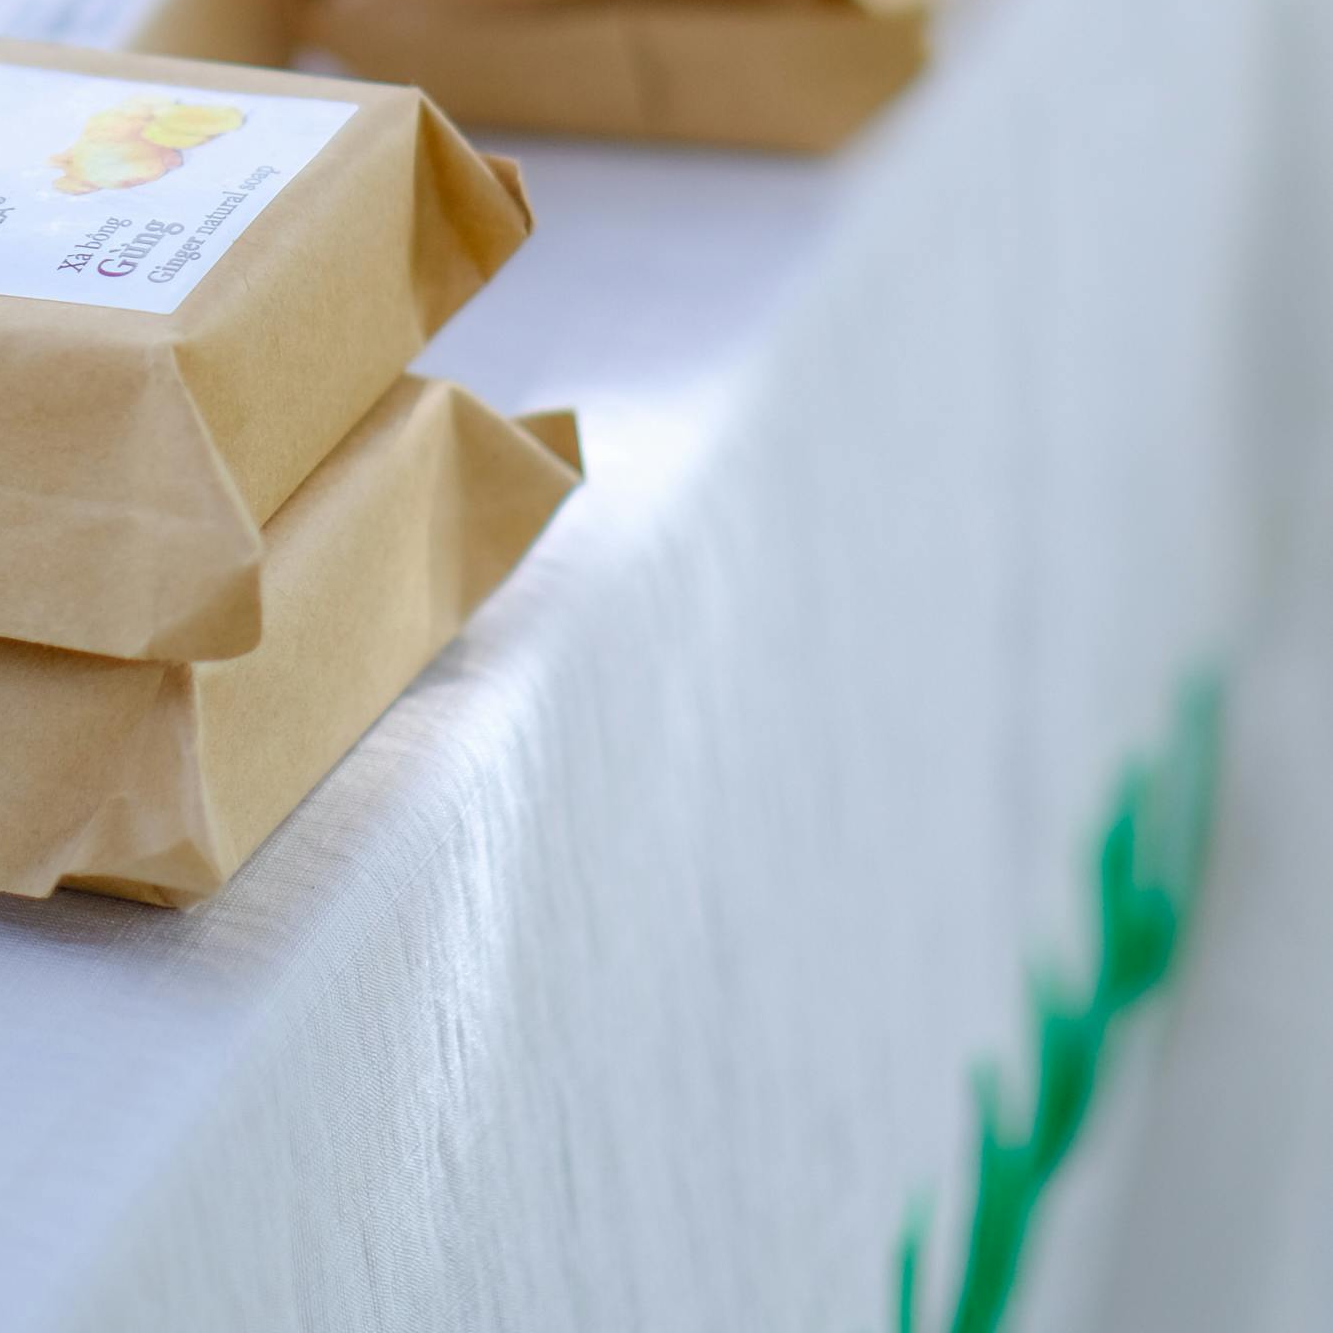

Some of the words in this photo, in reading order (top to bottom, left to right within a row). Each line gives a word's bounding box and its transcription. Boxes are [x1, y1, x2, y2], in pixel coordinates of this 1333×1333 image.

[74, 217, 133, 250] bông
[147, 236, 207, 284] Ginger
[201, 191, 249, 237] natural
[239, 165, 282, 191] soap
[57, 251, 95, 273] Xà
[97, 219, 186, 278] Gừng
